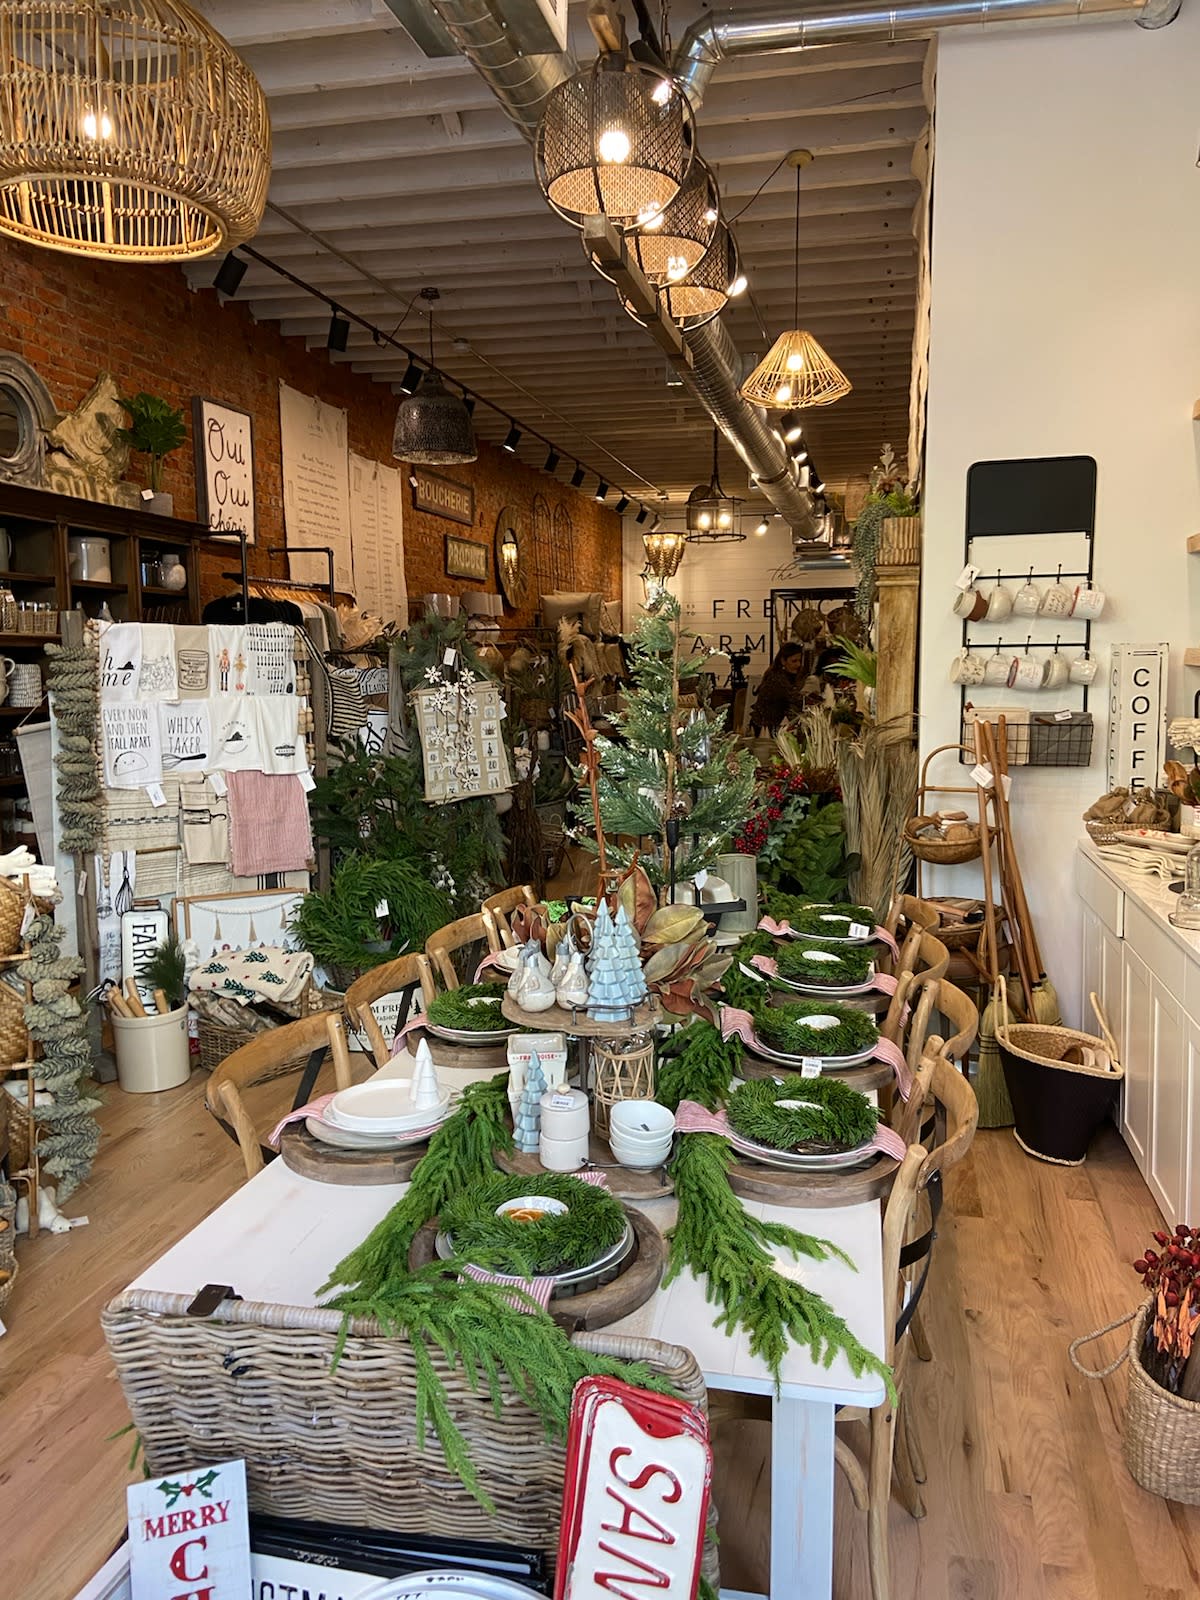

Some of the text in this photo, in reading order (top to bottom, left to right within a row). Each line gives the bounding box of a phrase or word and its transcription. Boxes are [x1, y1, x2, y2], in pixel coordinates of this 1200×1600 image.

[207, 418, 246, 465] Oui
[214, 470, 249, 507] Oui
[419, 480, 470, 515] BOUCHERIE
[766, 561, 809, 582] the
[713, 598, 834, 618] FRENC
[690, 634, 766, 654] ARM
[103, 708, 148, 721] EVERY NOW
[107, 722, 148, 736] AND THEN
[167, 717, 203, 735] WHISK
[1131, 668, 1150, 795] COFFE
[129, 735, 152, 749] APART
[169, 736, 201, 754] TAKER
[132, 923, 157, 979] FARM
[144, 1500, 231, 1541] MERRY
